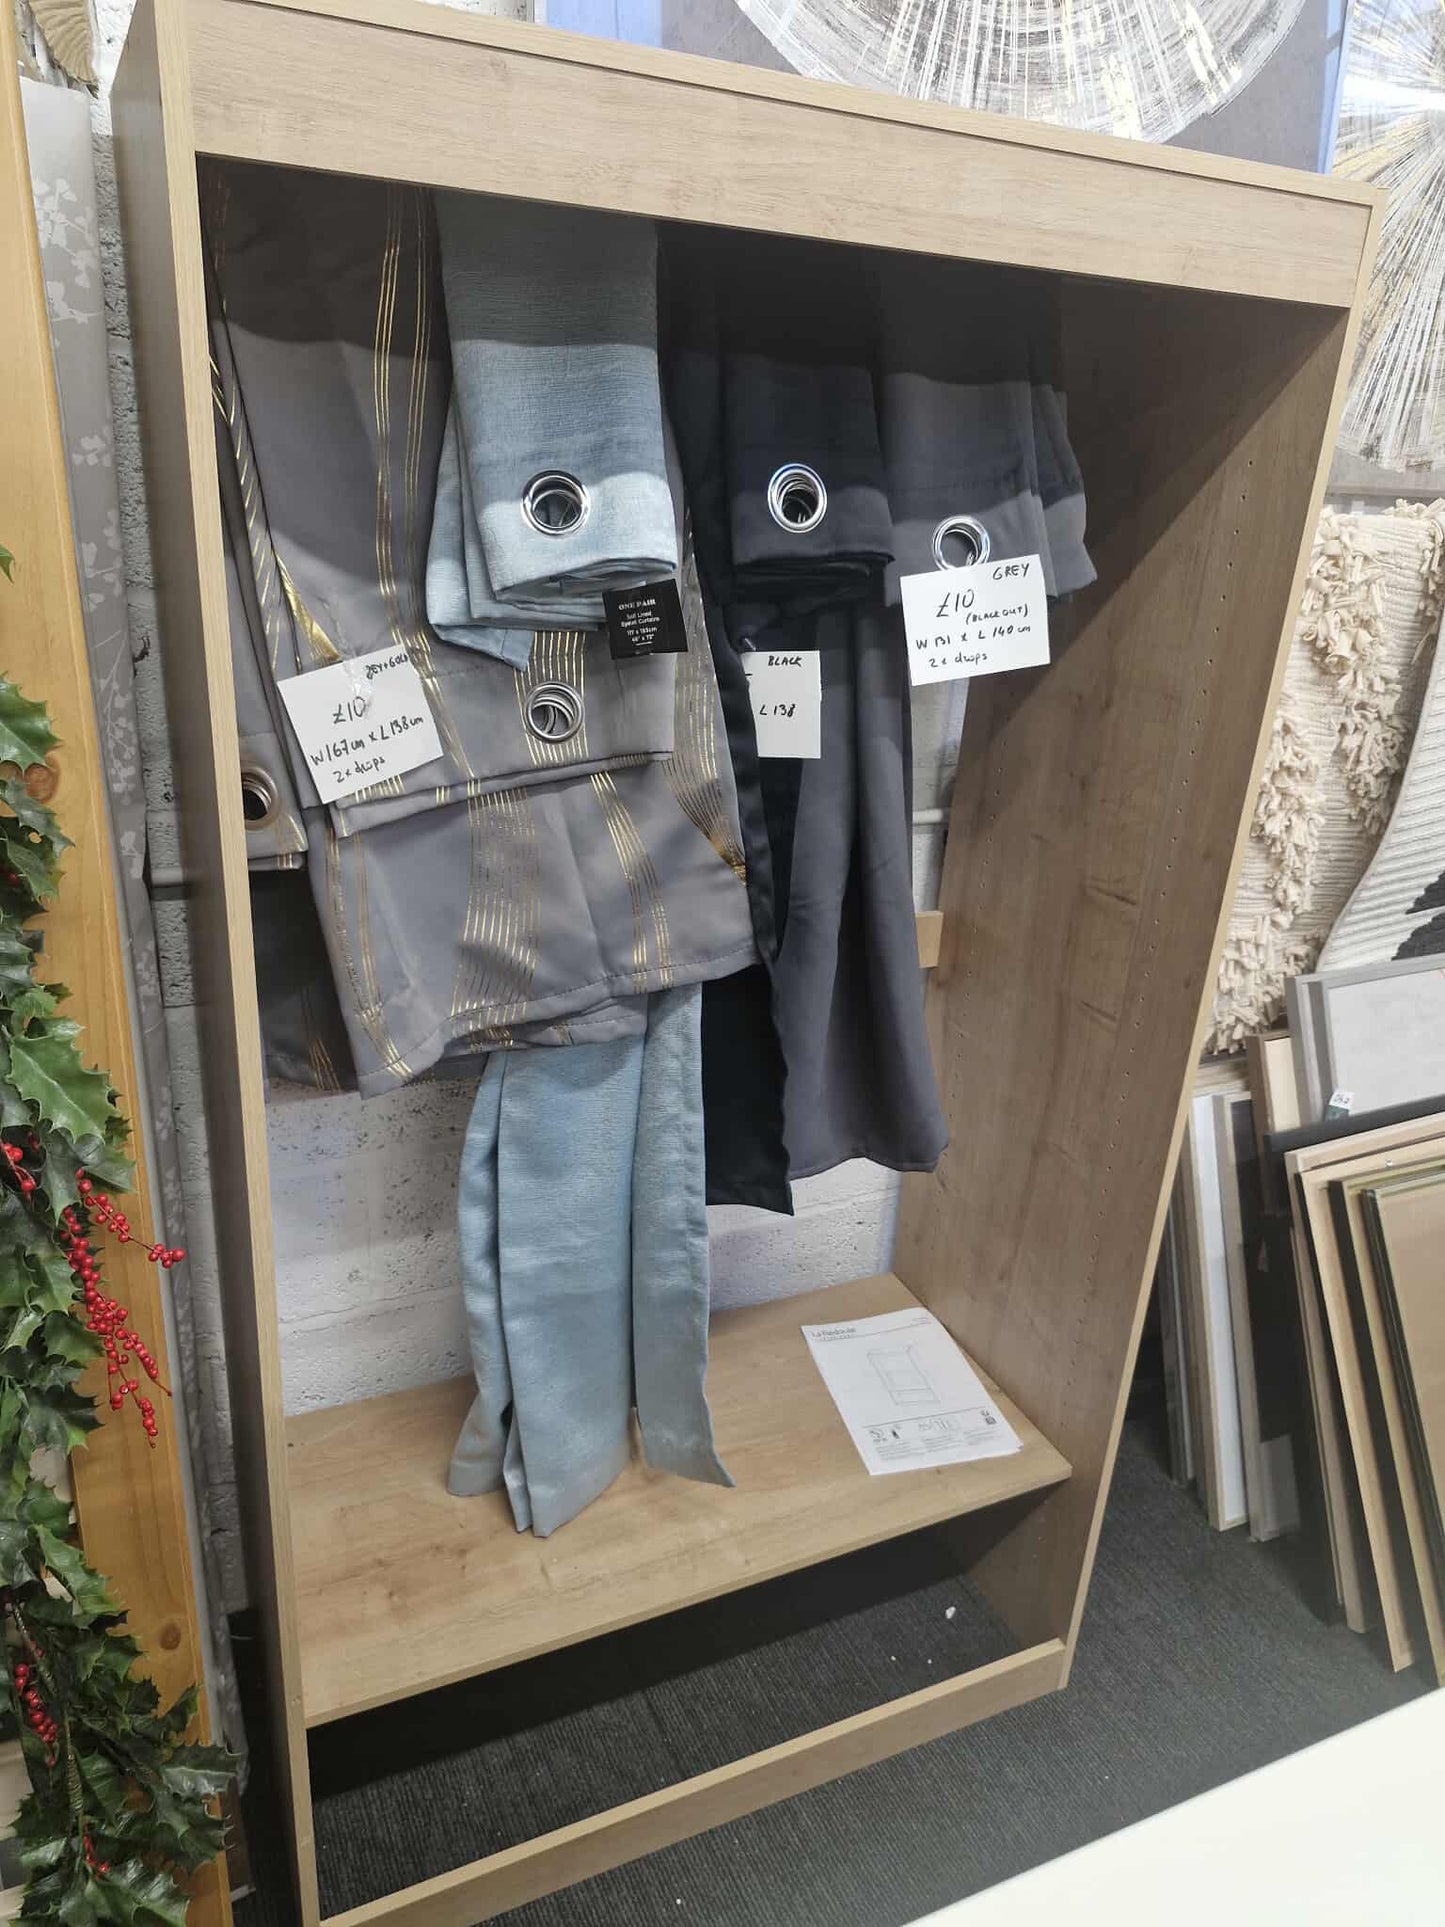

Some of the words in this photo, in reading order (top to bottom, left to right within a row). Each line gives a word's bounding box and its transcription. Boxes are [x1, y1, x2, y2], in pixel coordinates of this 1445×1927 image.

[992, 563, 1029, 580] GREY
[618, 602, 635, 611] ONE
[637, 599, 656, 607] PAIR
[936, 588, 975, 618] £10
[767, 655, 803, 668] BLACK
[954, 652, 988, 666] drops
[332, 696, 367, 725] £10
[354, 756, 386, 775] drops
